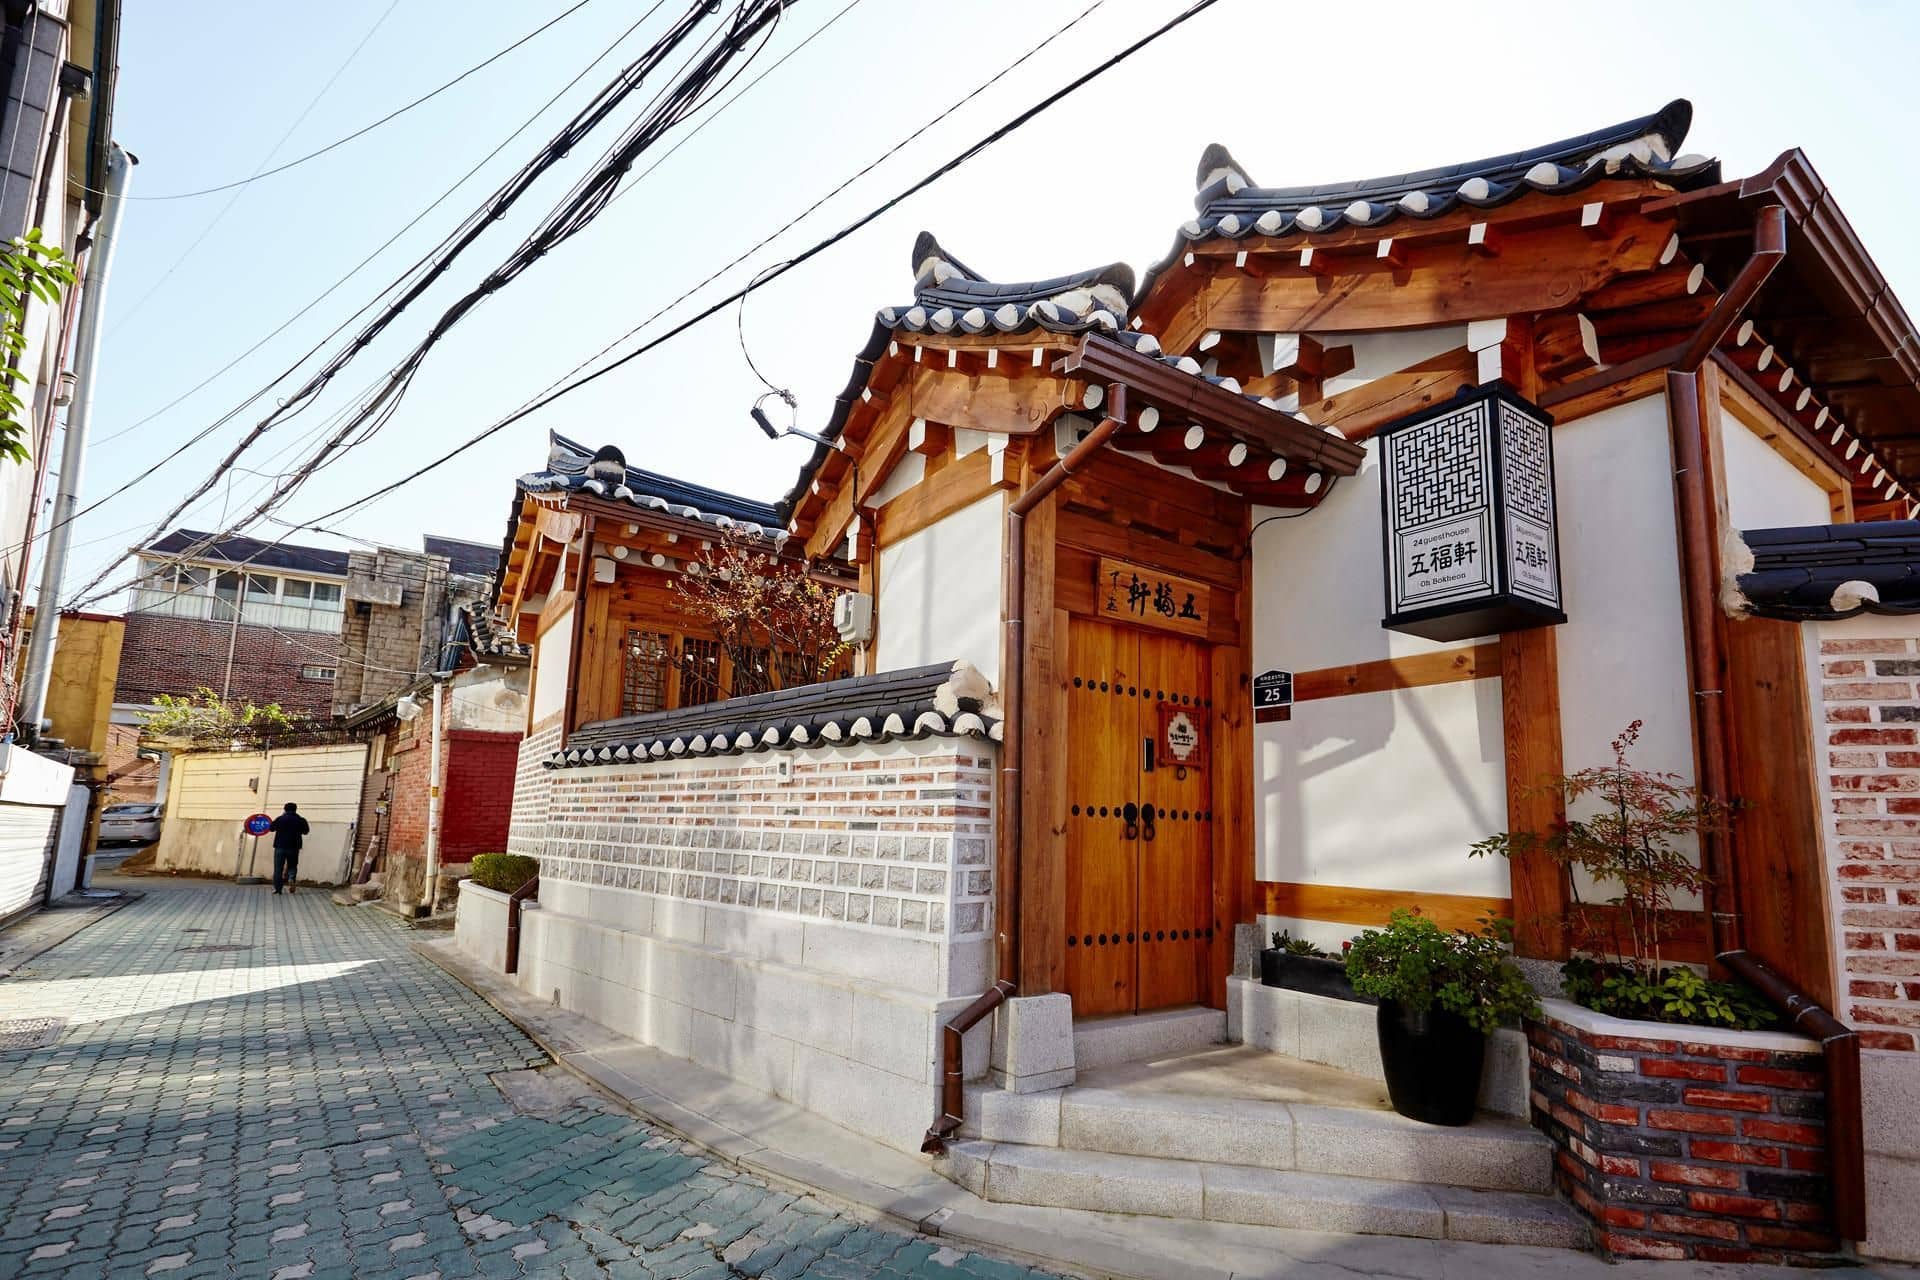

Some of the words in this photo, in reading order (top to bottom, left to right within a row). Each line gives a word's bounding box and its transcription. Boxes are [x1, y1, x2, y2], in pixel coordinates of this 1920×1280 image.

[1408, 541, 1478, 578] 五福軒
[1515, 540, 1548, 571] 五福軒
[1420, 580, 1431, 588] Oh
[1432, 572, 1466, 585] Bokheon
[1264, 688, 1280, 702] 25
